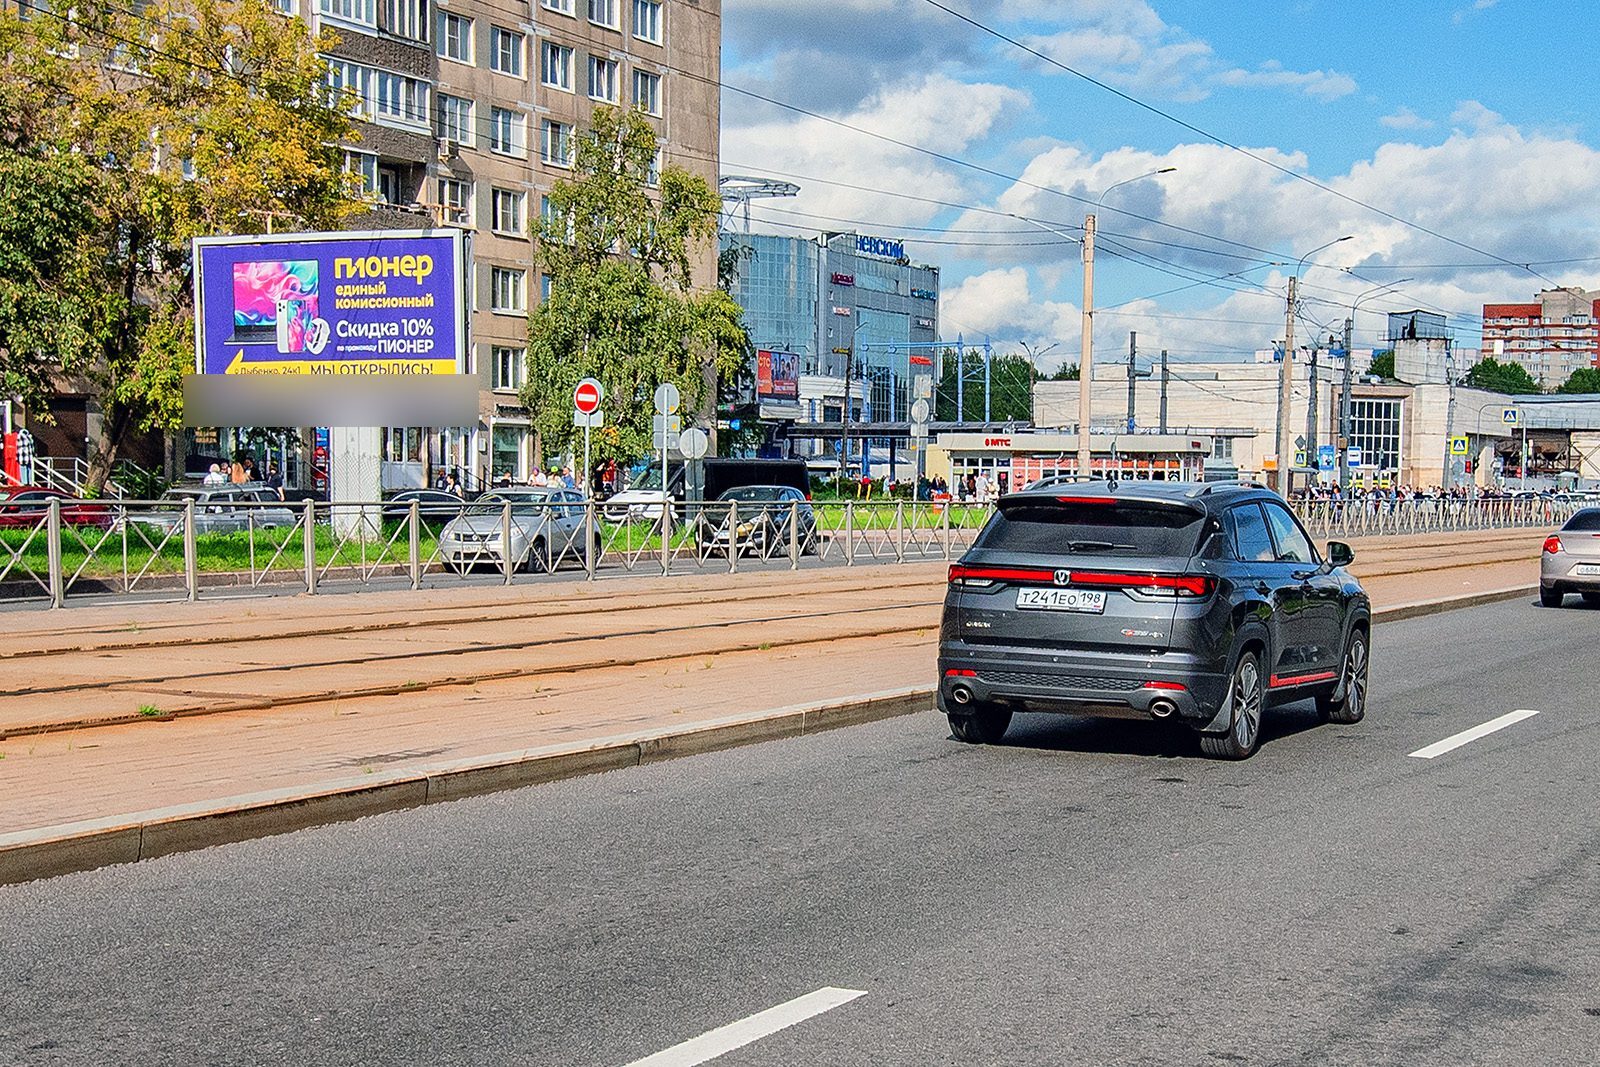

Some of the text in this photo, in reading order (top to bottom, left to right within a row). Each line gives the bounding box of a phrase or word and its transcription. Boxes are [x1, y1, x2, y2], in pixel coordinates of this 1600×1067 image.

[335, 281, 387, 297] единый
[335, 293, 434, 309] комиссионный
[336, 318, 434, 339] Скидка 10%
[377, 339, 434, 353] ПИОНЕР
[310, 363, 433, 374] МЫ ОТКРЫЛИСЬ!
[990, 438, 1011, 447] МТС
